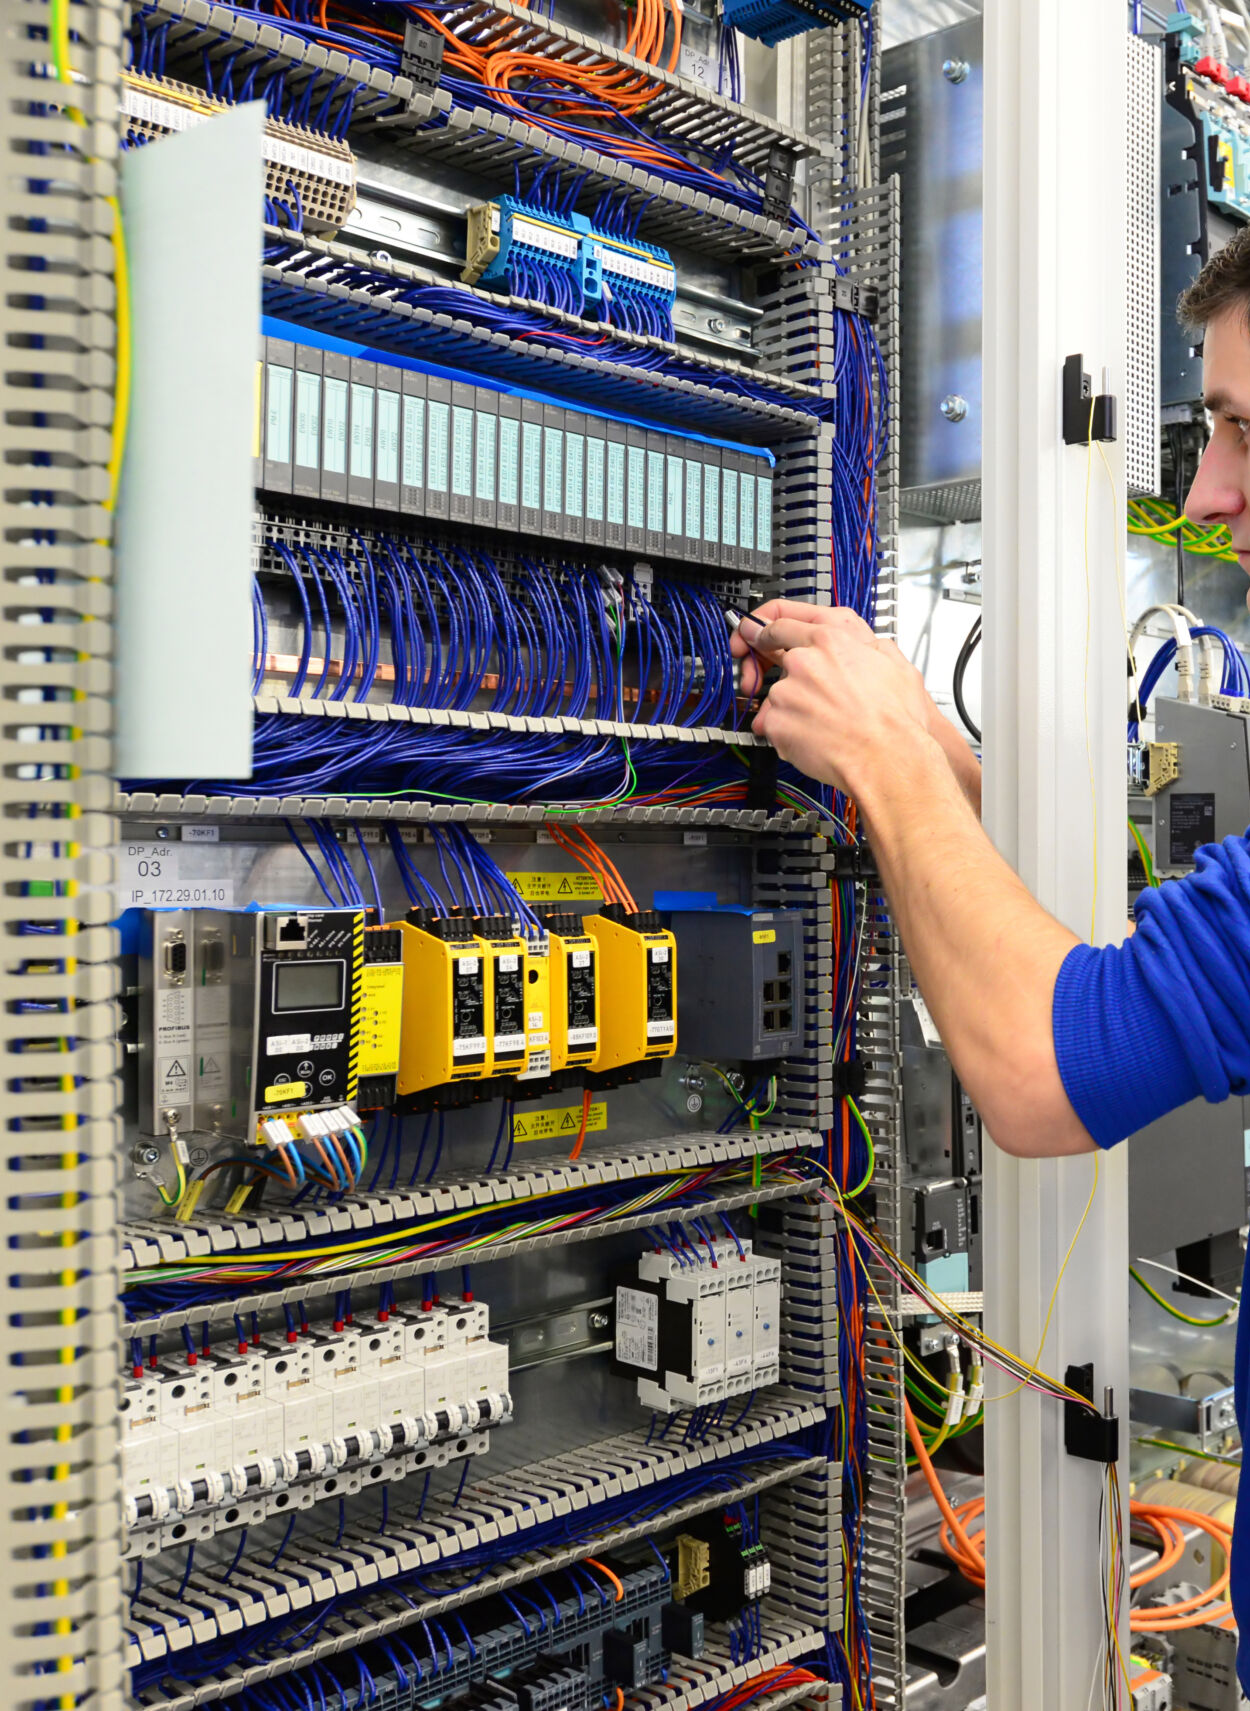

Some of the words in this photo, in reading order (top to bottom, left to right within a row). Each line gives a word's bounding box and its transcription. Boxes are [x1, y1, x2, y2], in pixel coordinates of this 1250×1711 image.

[691, 64, 704, 79] 12
[128, 846, 172, 858] DP_Adr.
[138, 860, 162, 878] 03
[131, 888, 226, 904] IP_172.29.01.10
